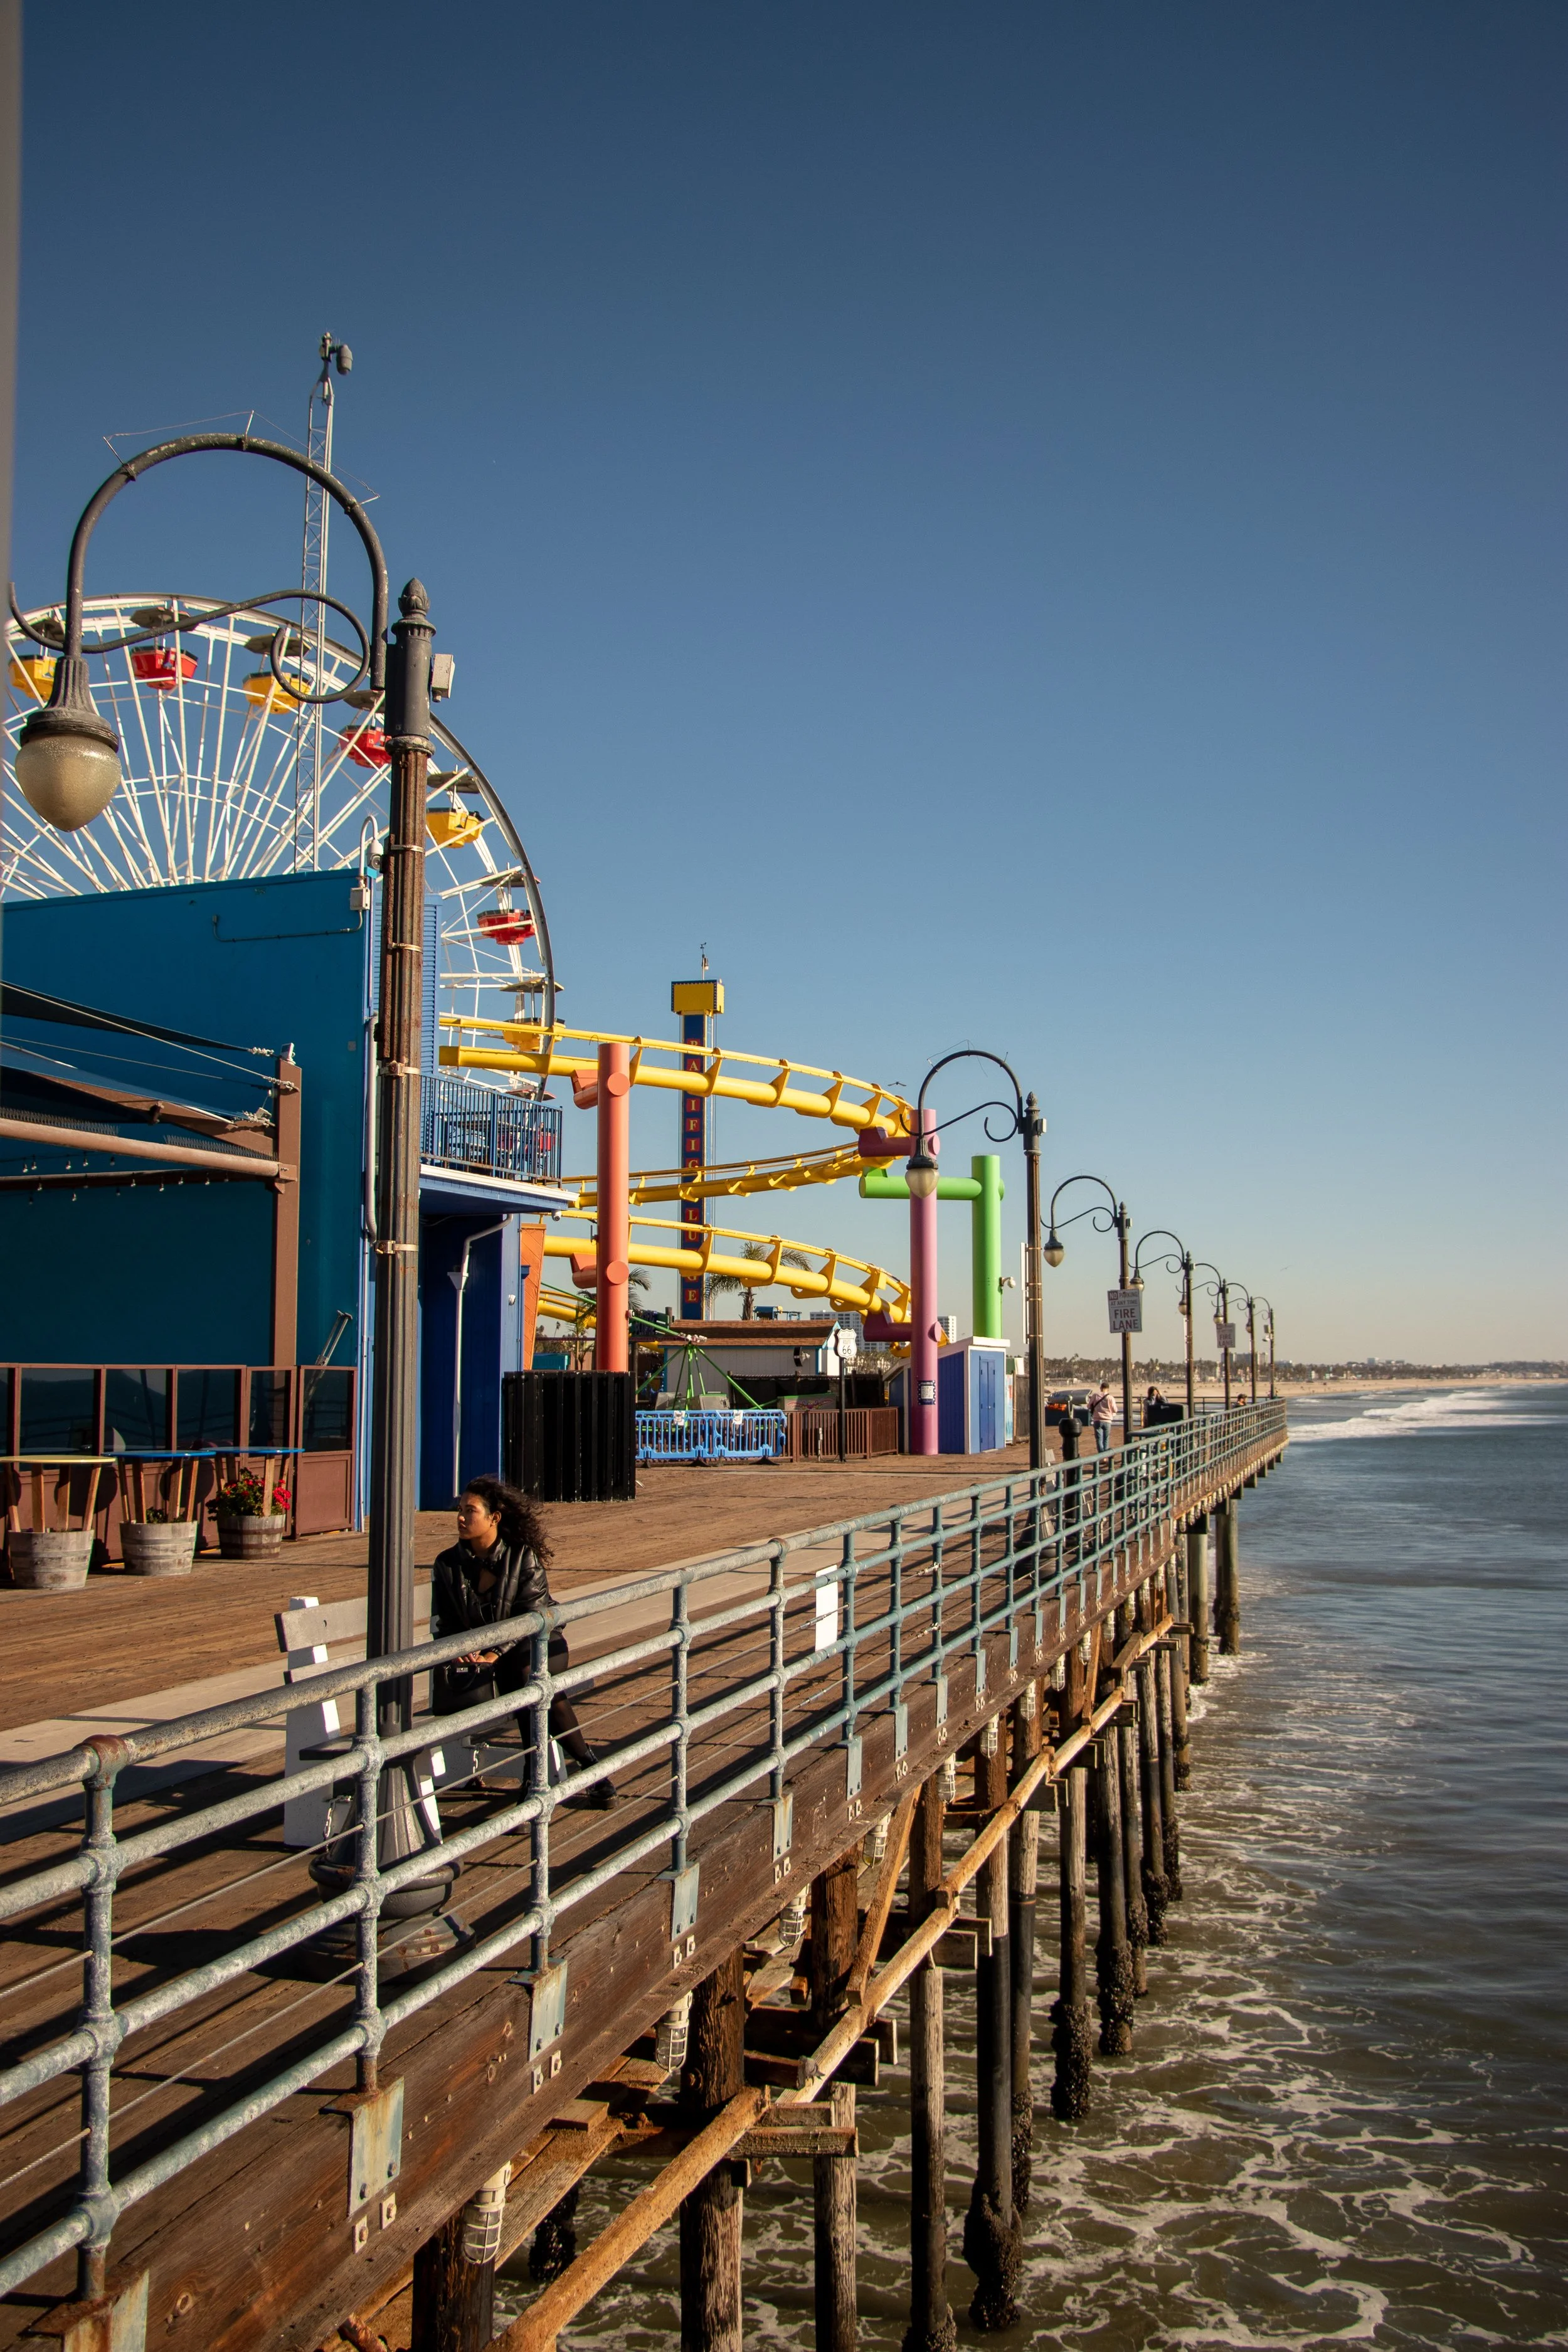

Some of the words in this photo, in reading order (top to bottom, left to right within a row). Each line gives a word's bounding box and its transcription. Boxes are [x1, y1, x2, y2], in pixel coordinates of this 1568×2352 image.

[689, 1039, 698, 1169] PAIFIC
[1114, 1308, 1136, 1319] FIRE
[1113, 1319, 1139, 1330] LANE
[842, 1345, 852, 1355] 66
